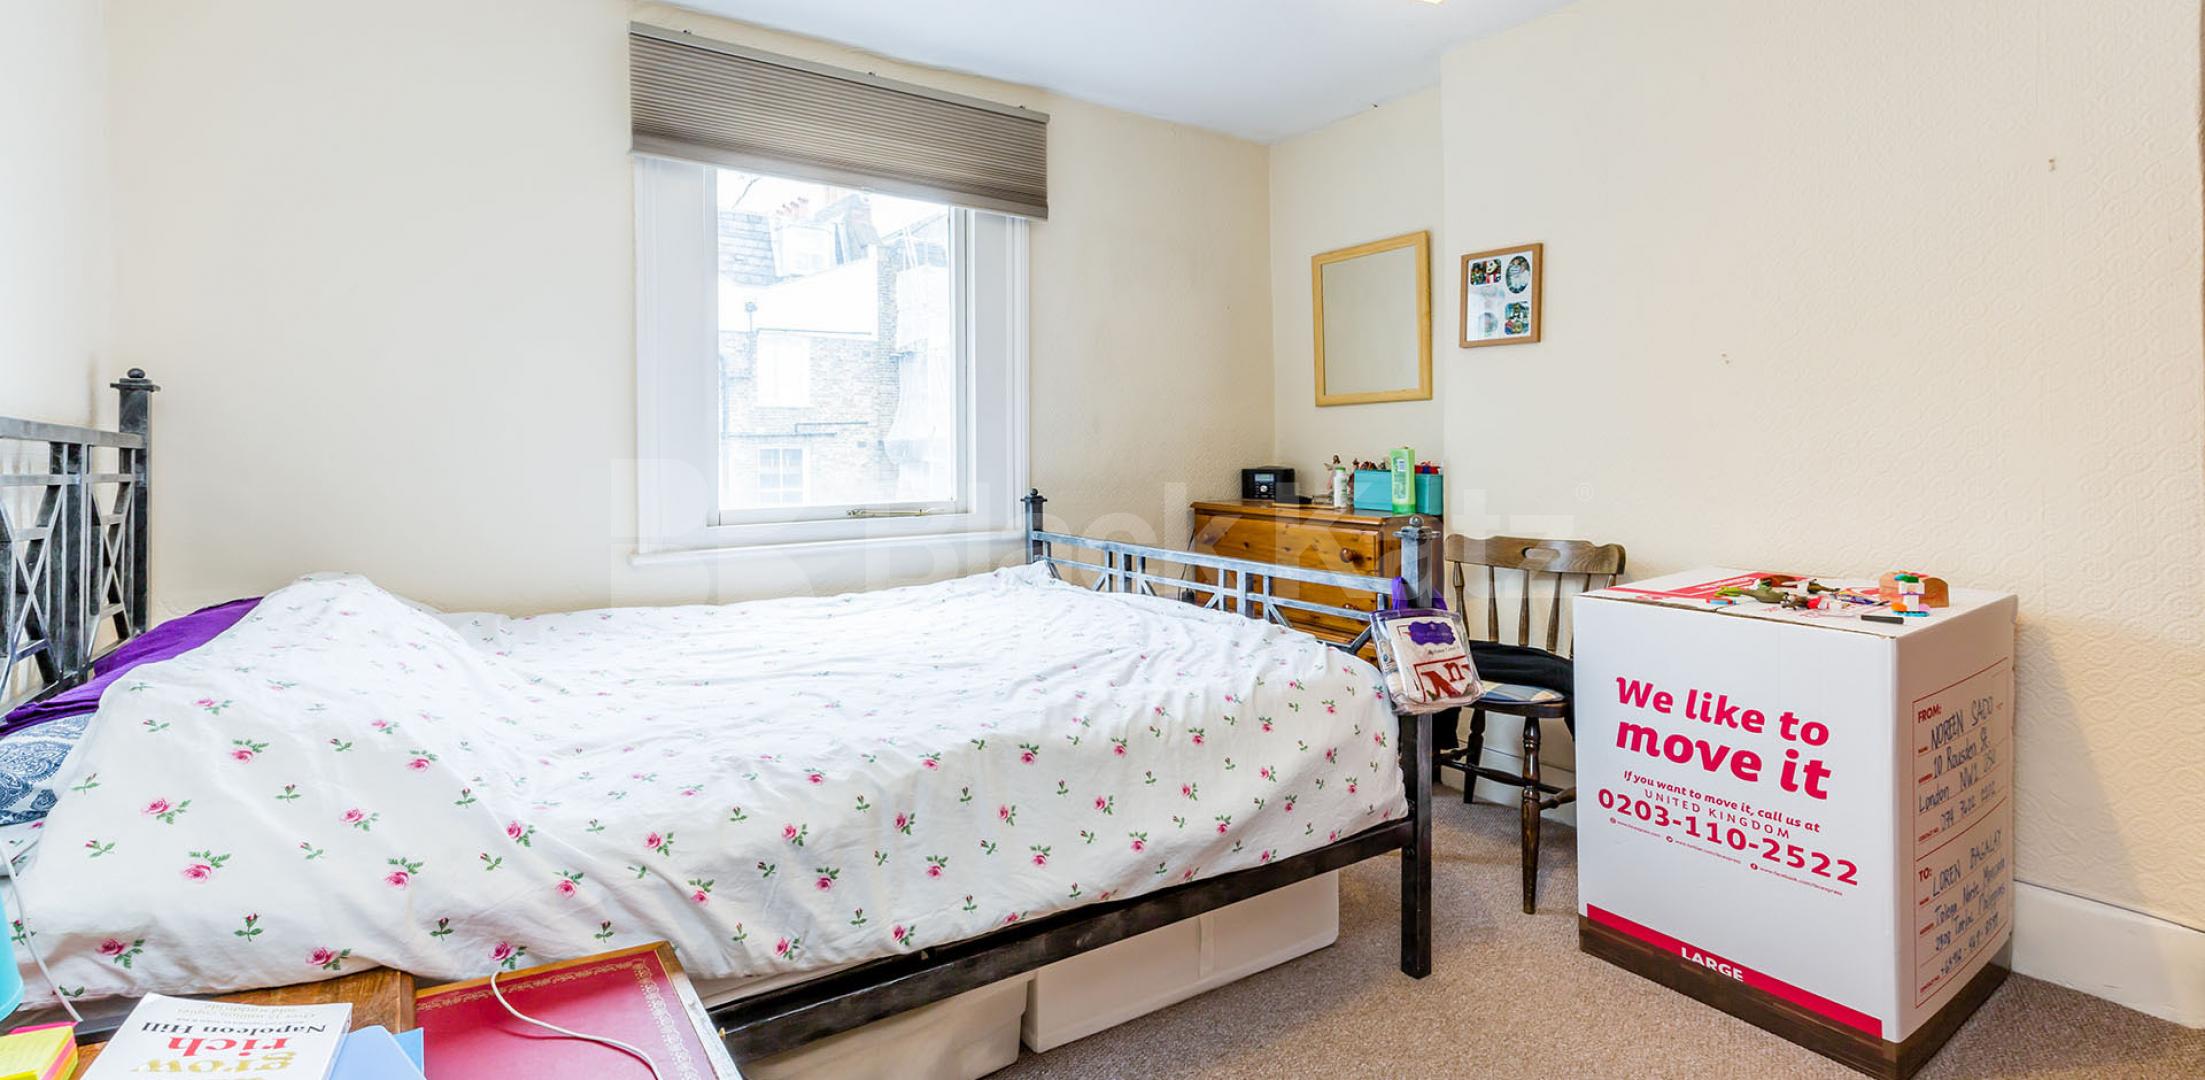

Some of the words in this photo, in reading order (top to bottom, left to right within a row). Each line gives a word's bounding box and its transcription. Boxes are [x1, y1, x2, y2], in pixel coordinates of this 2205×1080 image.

[1616, 676, 1674, 714] We
[1685, 689, 1765, 734] like
[1779, 711, 1829, 746] to
[1917, 703, 1942, 724] FROM:
[1616, 721, 1762, 782] move
[1779, 749, 1832, 800] it
[1624, 770, 1632, 781] If
[1633, 774, 1654, 787] you
[1657, 780, 1687, 796] want
[1689, 789, 1702, 800] to
[1704, 794, 1738, 810] move
[1741, 801, 1754, 816] it,
[1757, 809, 1782, 823] call
[1786, 816, 1801, 828] us
[1805, 822, 1820, 833] at
[1918, 783, 1950, 813] London
[1644, 788, 1700, 813] UNITED
[1708, 808, 1789, 839] KINGDOM
[1598, 788, 1857, 886] 0203-110-2522
[1918, 867, 1932, 882] TO:
[1681, 946, 1744, 982] LARGE
[141, 1022, 192, 1034] Hill
[203, 1024, 326, 1035] Napoleon
[131, 1051, 297, 1072] grow
[167, 1036, 290, 1057] rich
